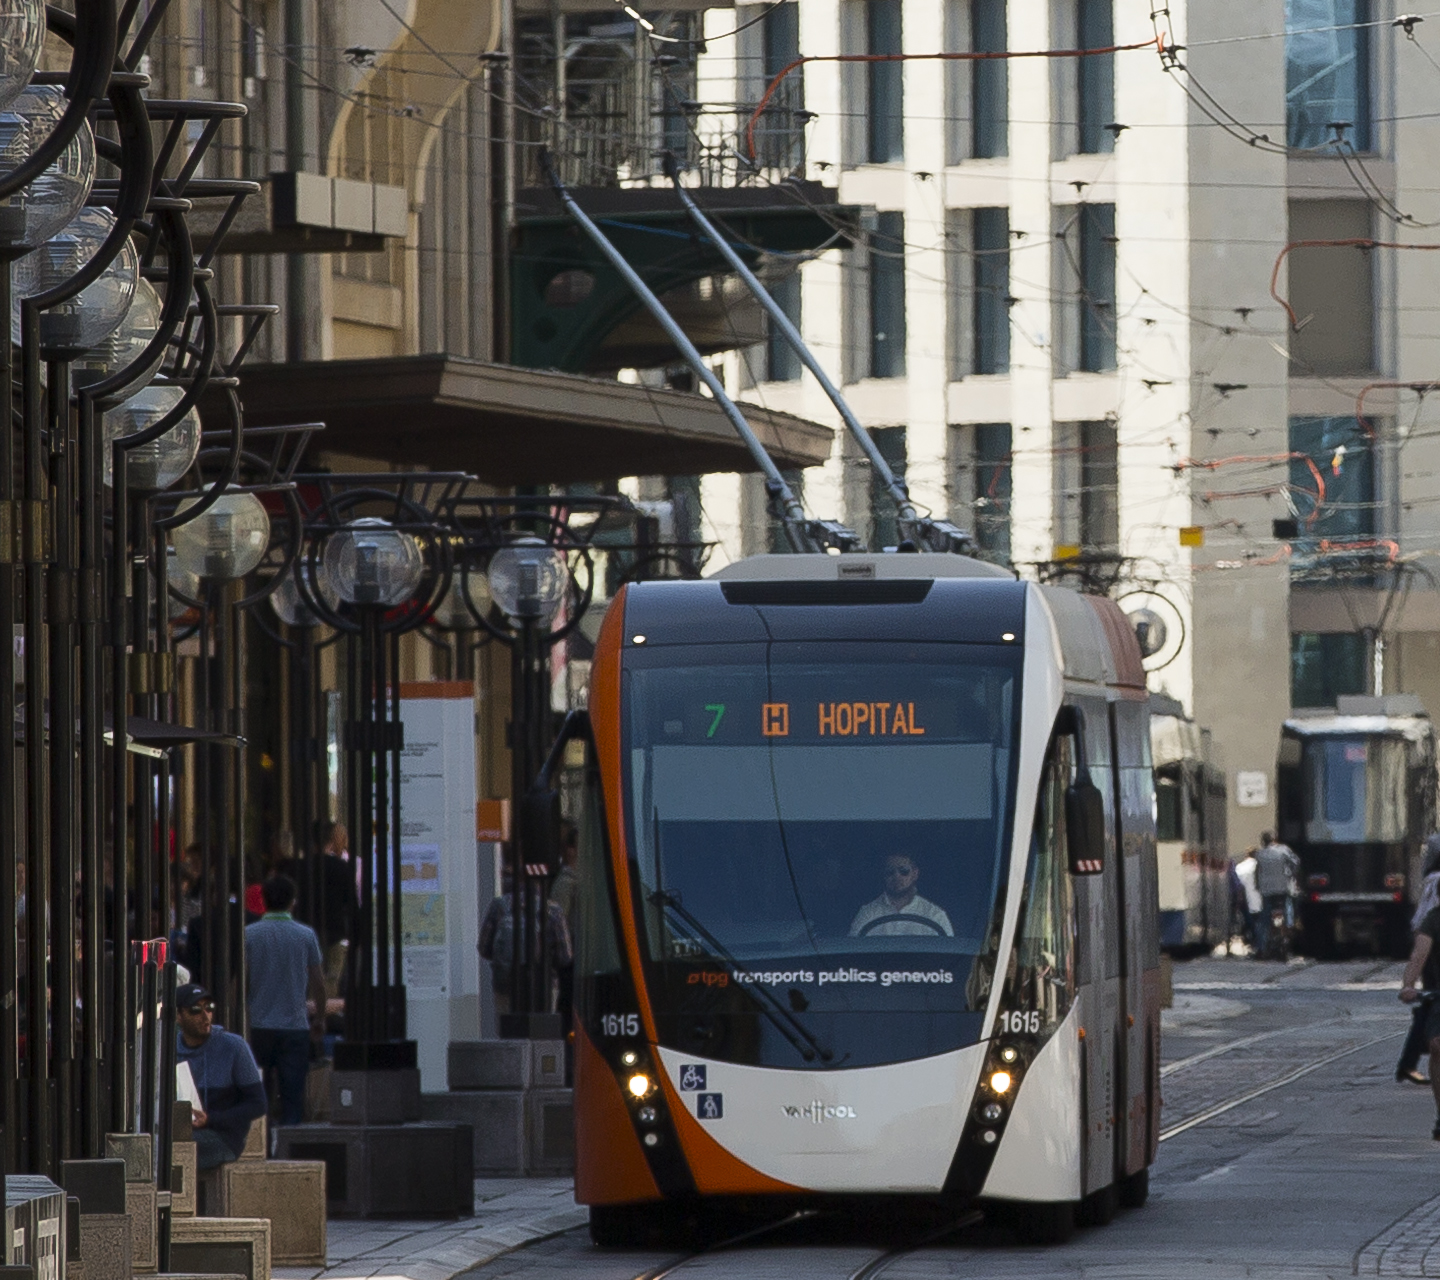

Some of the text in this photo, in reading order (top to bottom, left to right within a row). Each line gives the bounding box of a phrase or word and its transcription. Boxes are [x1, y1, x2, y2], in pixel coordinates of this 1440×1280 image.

[703, 703, 726, 738] 7
[818, 701, 925, 735] HOPITAL
[702, 968, 954, 987] tpg transports publics genevois
[601, 1013, 640, 1037] 1615
[1000, 1010, 1041, 1035] 1615
